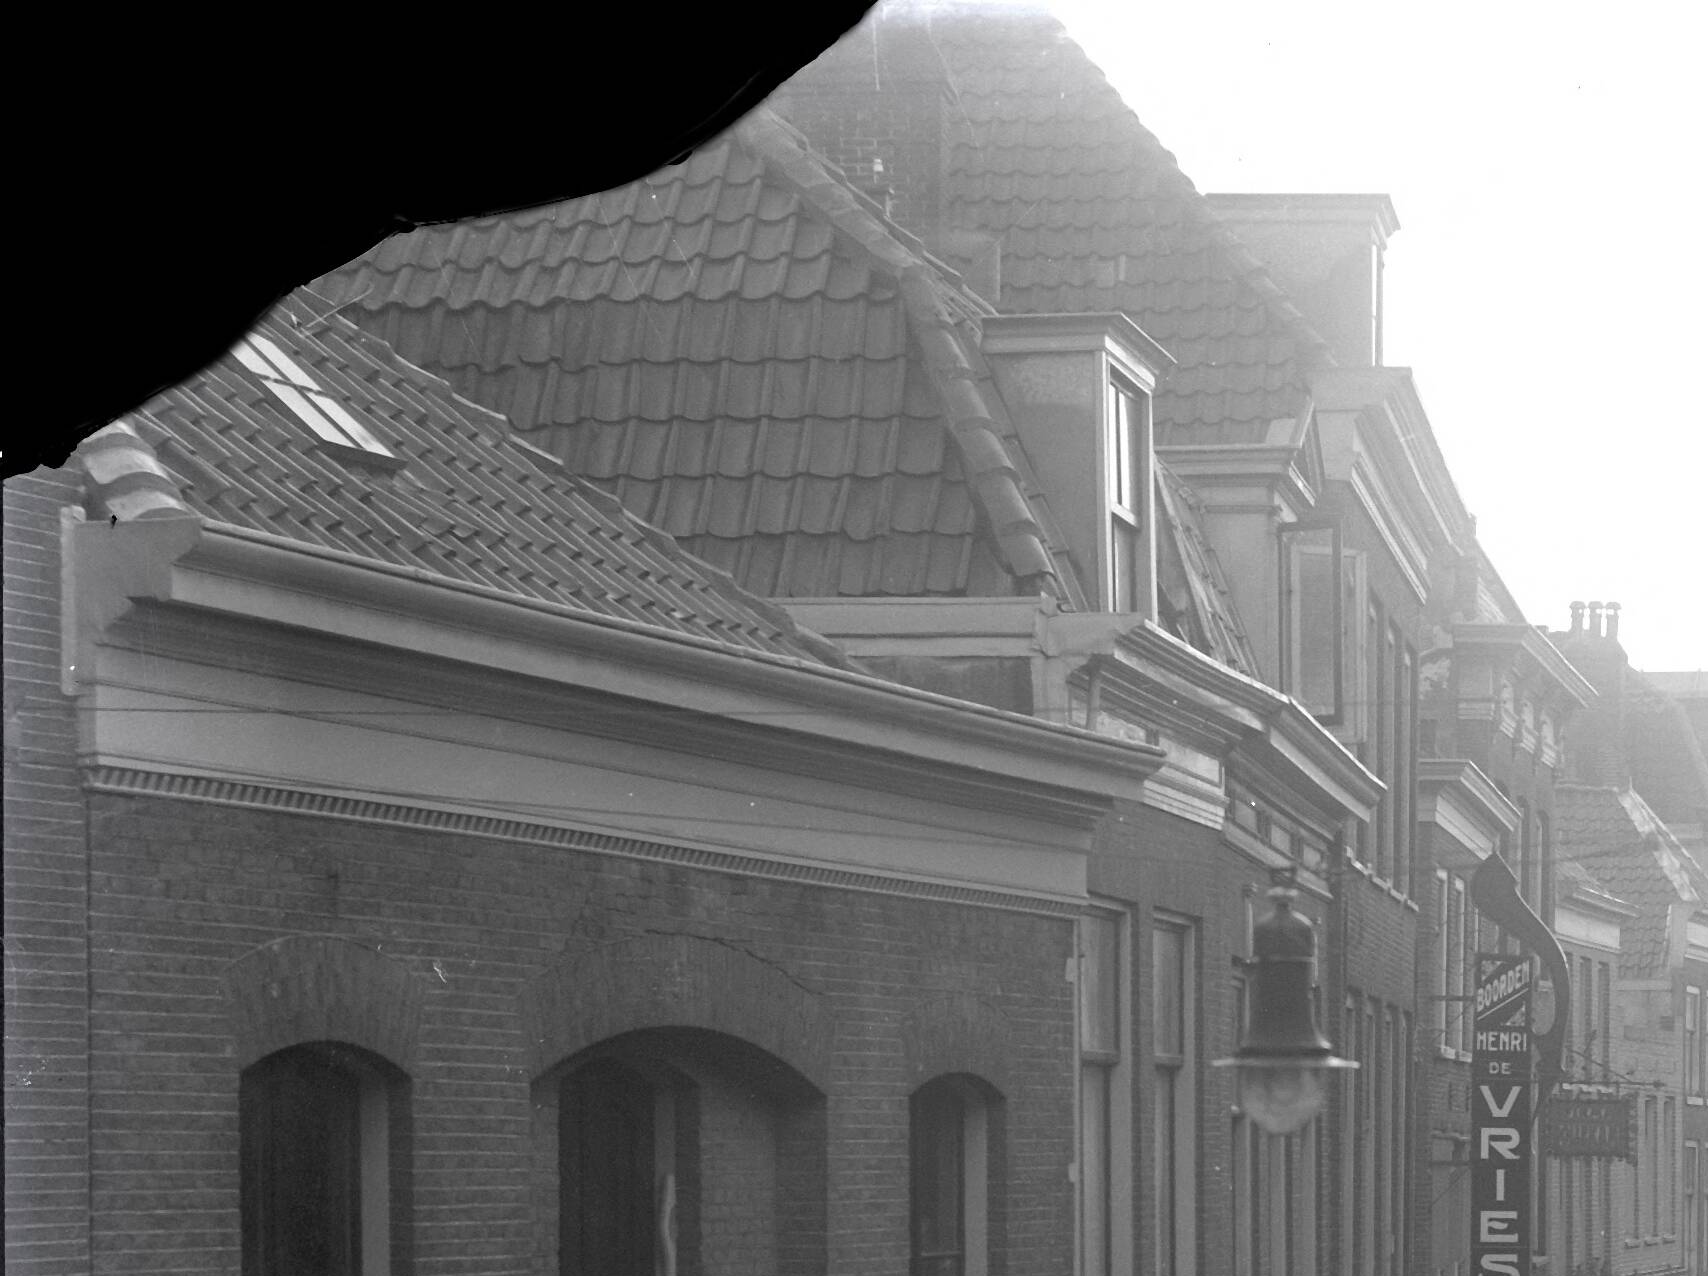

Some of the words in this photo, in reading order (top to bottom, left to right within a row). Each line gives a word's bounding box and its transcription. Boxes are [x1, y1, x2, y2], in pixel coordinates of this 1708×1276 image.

[1476, 959, 1530, 1013] BOORDEN
[1476, 1031, 1528, 1052] HENRI
[1488, 1061, 1512, 1075] DE
